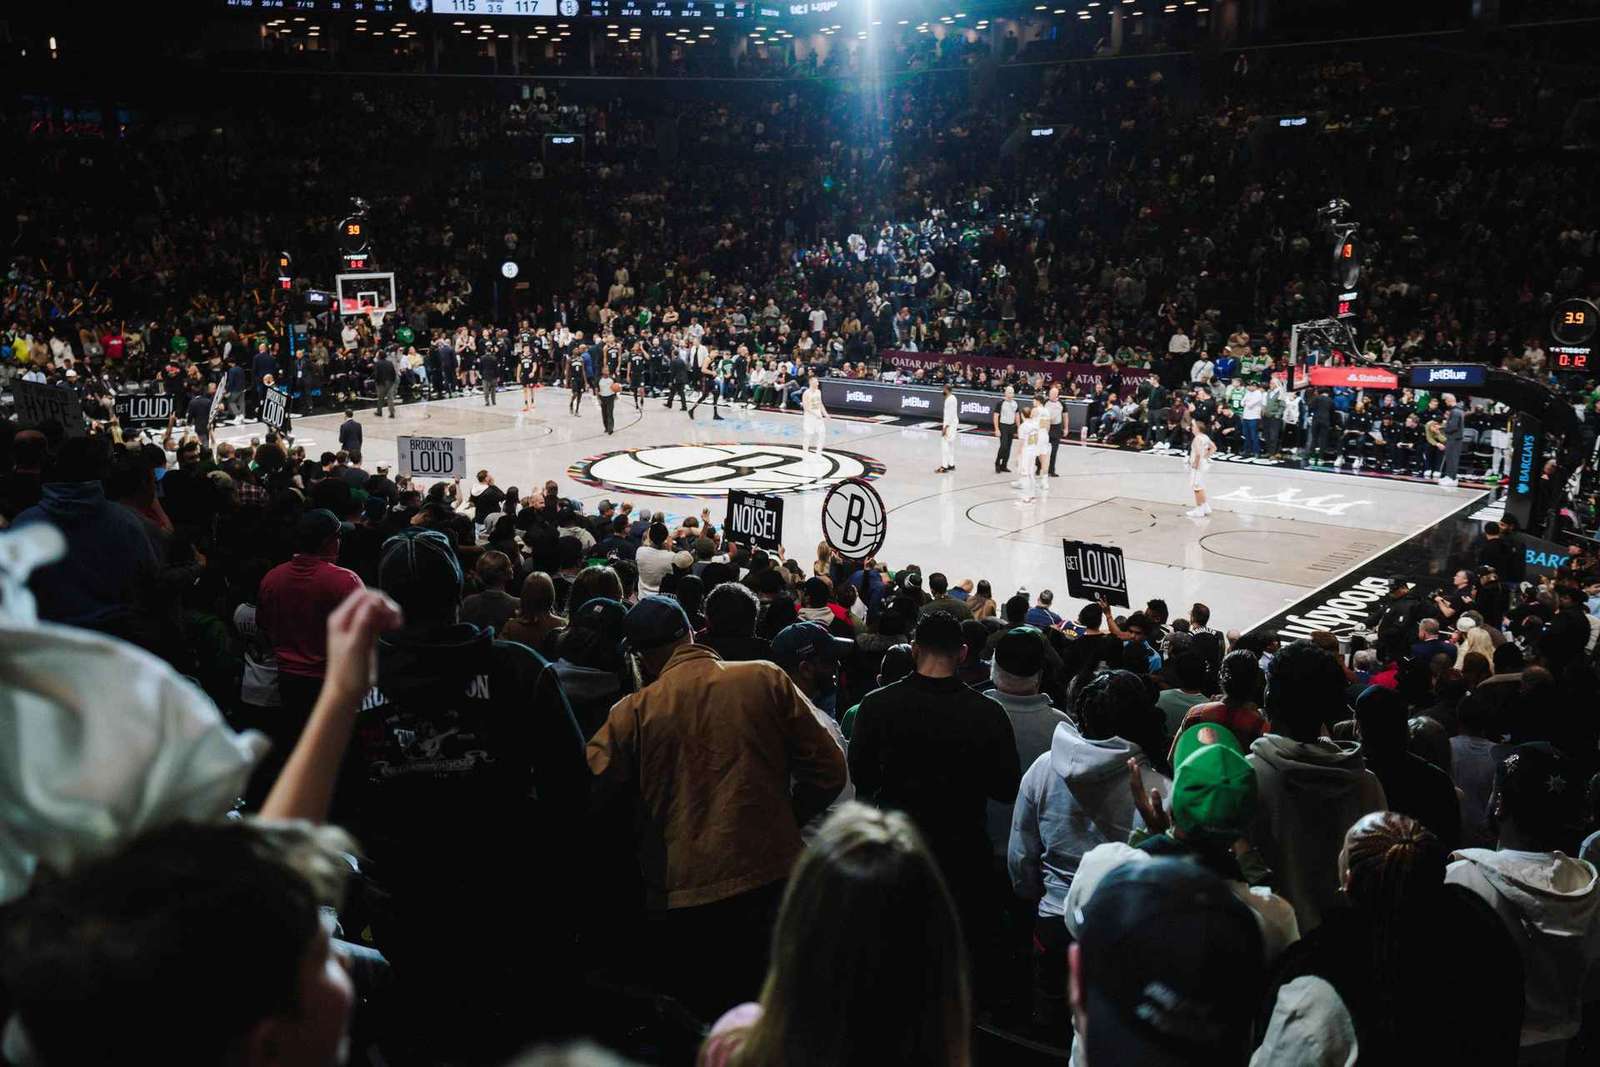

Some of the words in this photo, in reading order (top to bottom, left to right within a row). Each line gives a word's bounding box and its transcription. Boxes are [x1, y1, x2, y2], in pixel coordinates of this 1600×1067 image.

[453, 0, 476, 11] 115
[515, 0, 538, 12] 117
[1565, 312, 1585, 324] 3.9
[891, 356, 922, 370] QATAR
[1559, 354, 1587, 367] 0:12
[1428, 369, 1468, 383] jetBlue
[846, 391, 873, 403] jetBlue
[902, 396, 930, 409] jetBlue
[262, 398, 285, 427] LOUD
[961, 401, 991, 415] jetBlue
[409, 439, 453, 452] BROOKLYN
[410, 451, 454, 473] LOUD
[1519, 435, 1535, 482] BARCLAYS
[732, 502, 777, 541] NOISE!
[1065, 555, 1079, 571] GET
[1078, 547, 1126, 590] LOUD!
